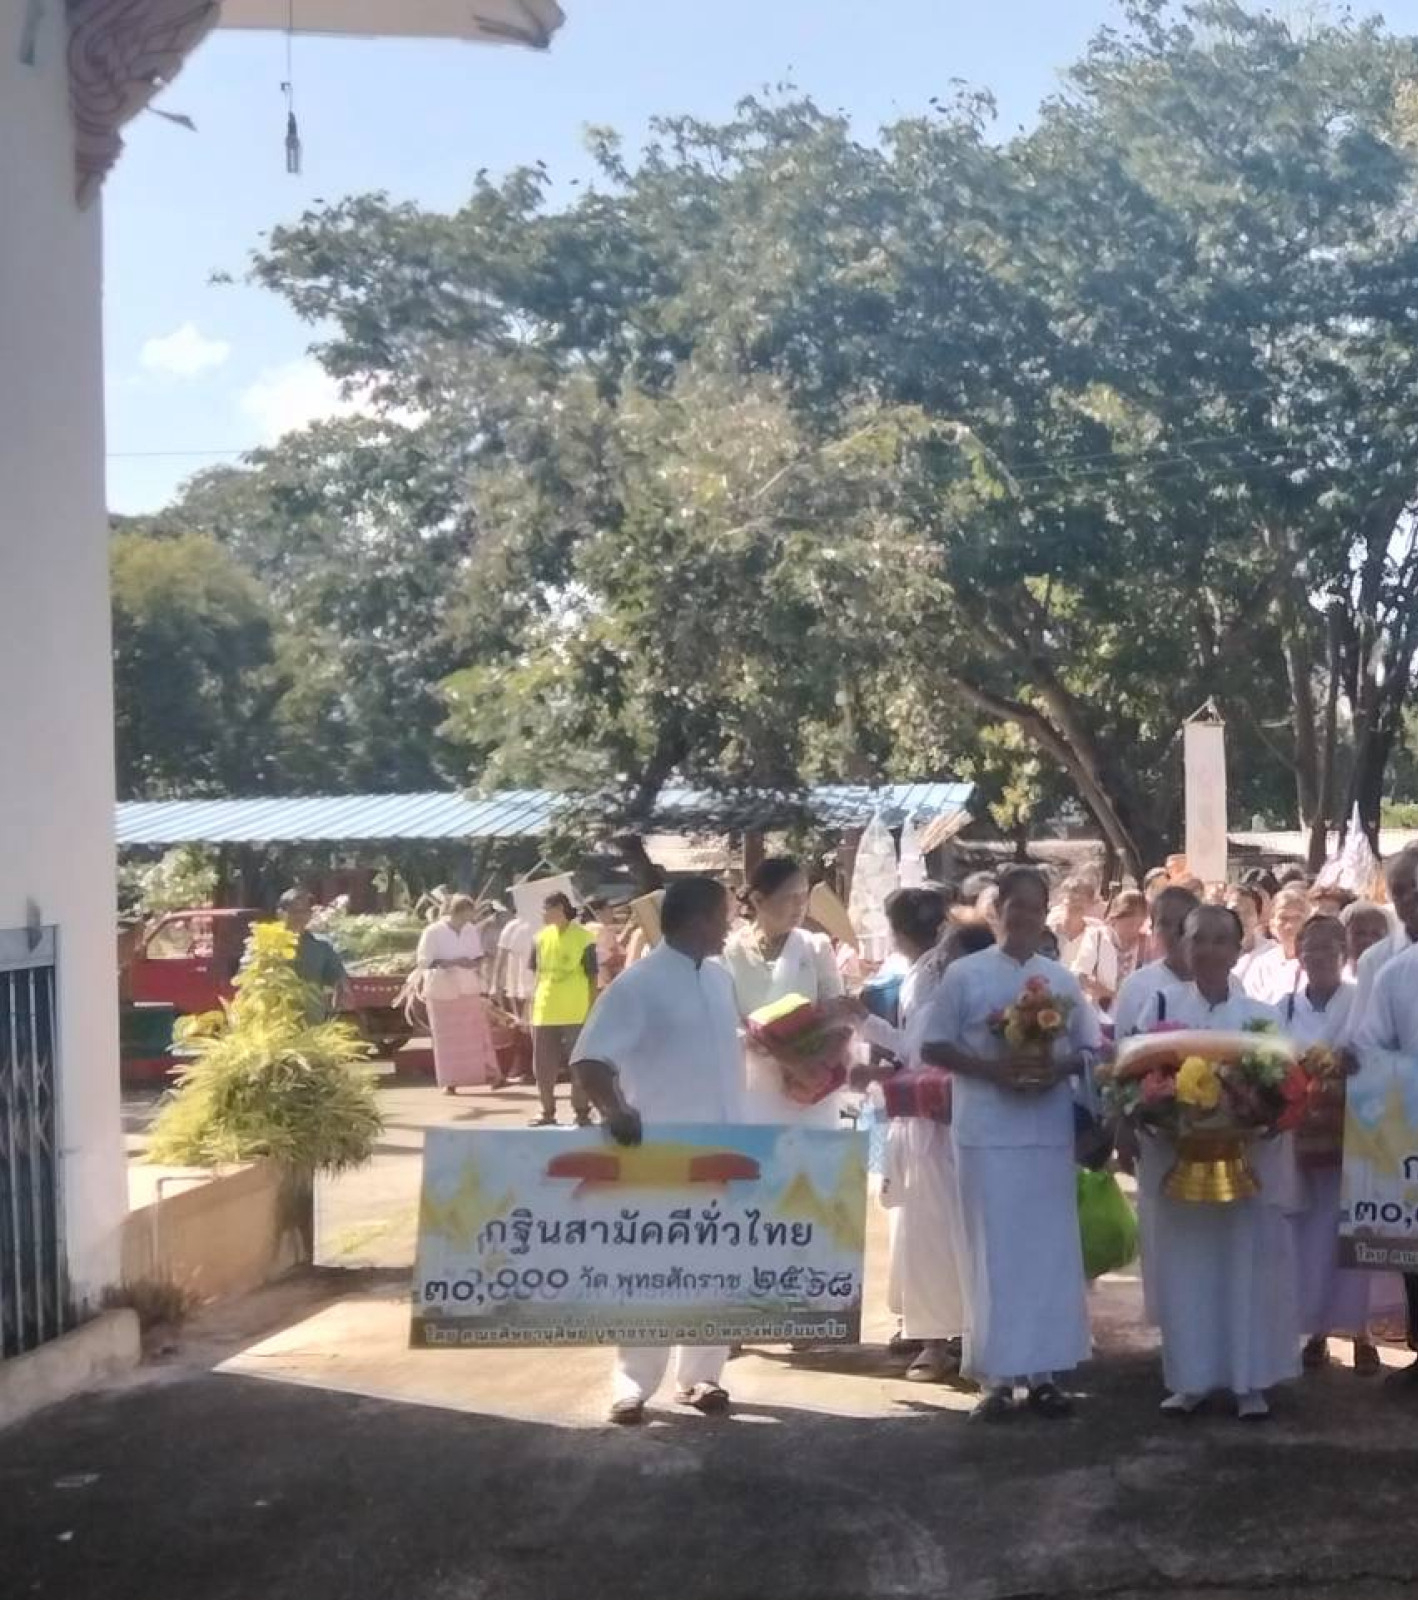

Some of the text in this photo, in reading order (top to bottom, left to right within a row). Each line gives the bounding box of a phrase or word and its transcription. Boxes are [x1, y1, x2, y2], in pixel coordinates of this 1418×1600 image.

[480, 1199, 813, 1255] กฐินสามัคคีทั่วไทย
[424, 1264, 853, 1304] ๓๐,๐๐๐ วัด พุทธศักราช ๒๕๖๘
